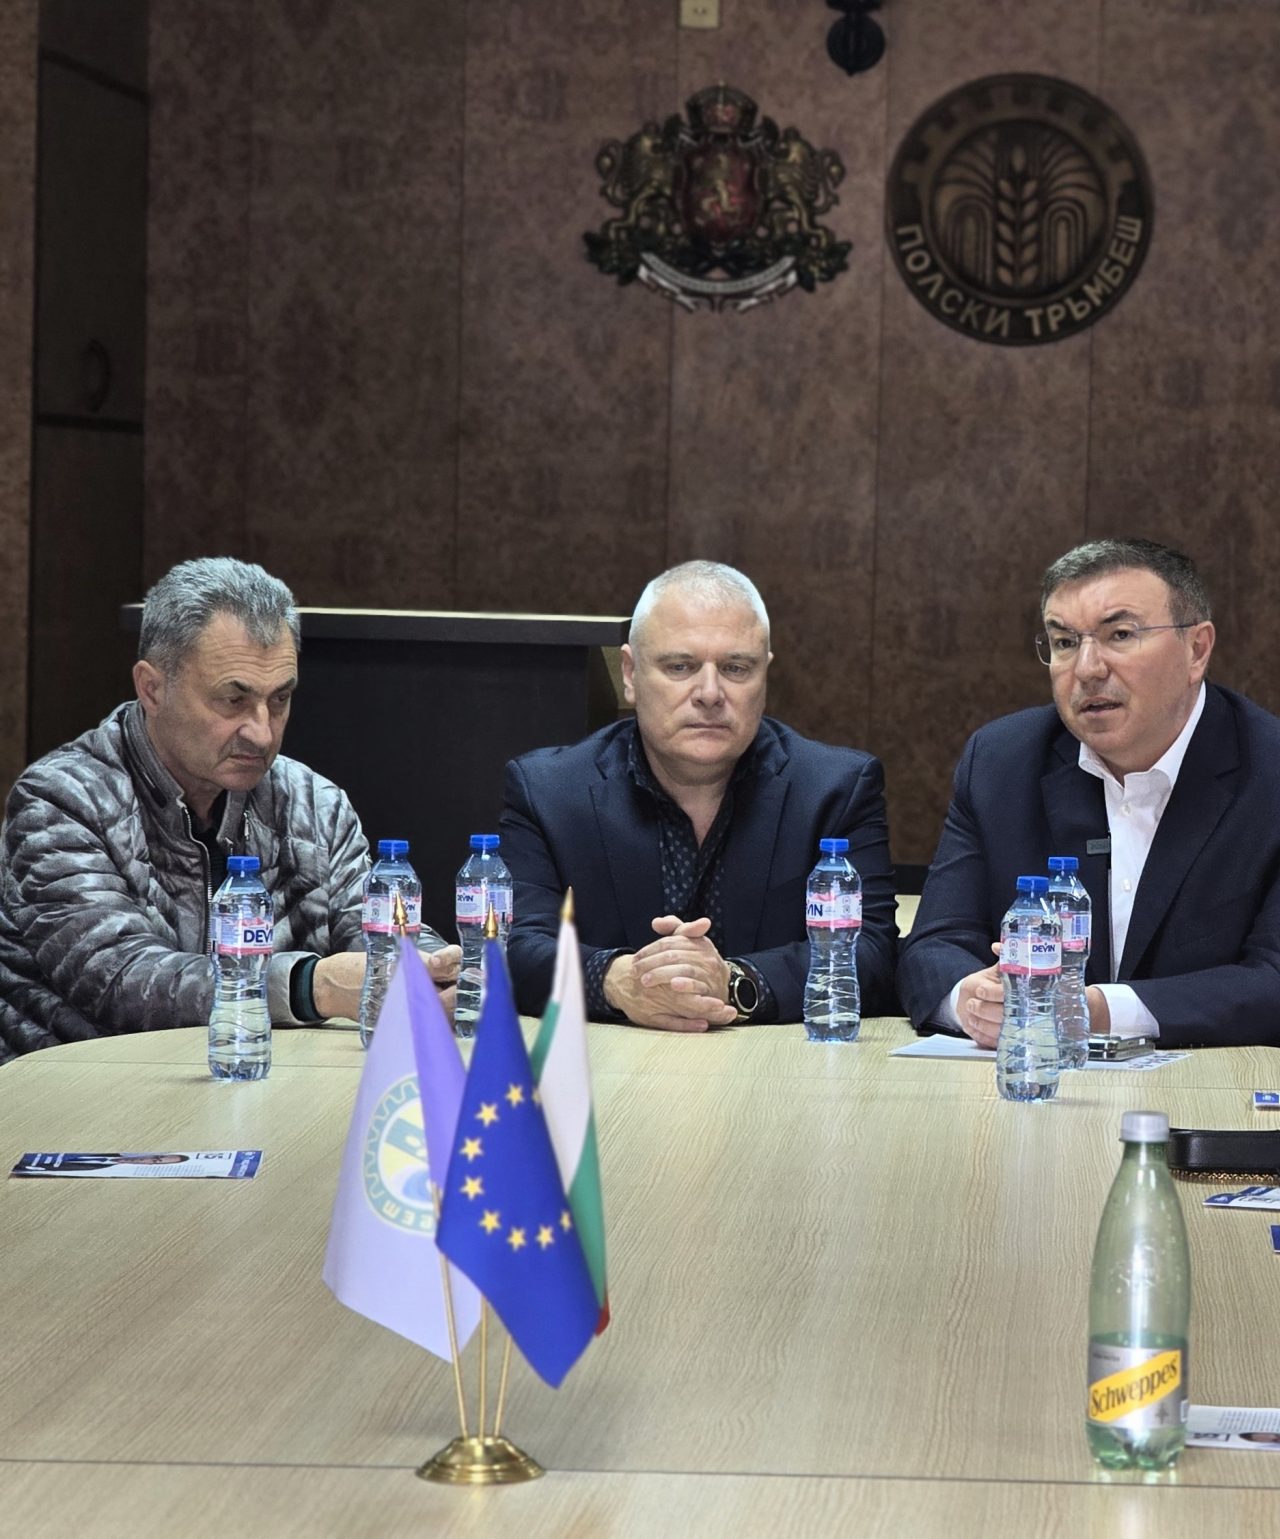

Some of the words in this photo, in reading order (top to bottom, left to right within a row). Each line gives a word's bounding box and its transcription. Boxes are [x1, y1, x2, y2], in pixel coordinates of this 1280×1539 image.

[897, 224, 1011, 337] ПОЛСКИ
[1024, 216, 1142, 337] ТРЪМБЕШ
[1032, 943, 1056, 953] DEVIN
[1091, 1358, 1177, 1417] Schweppes
